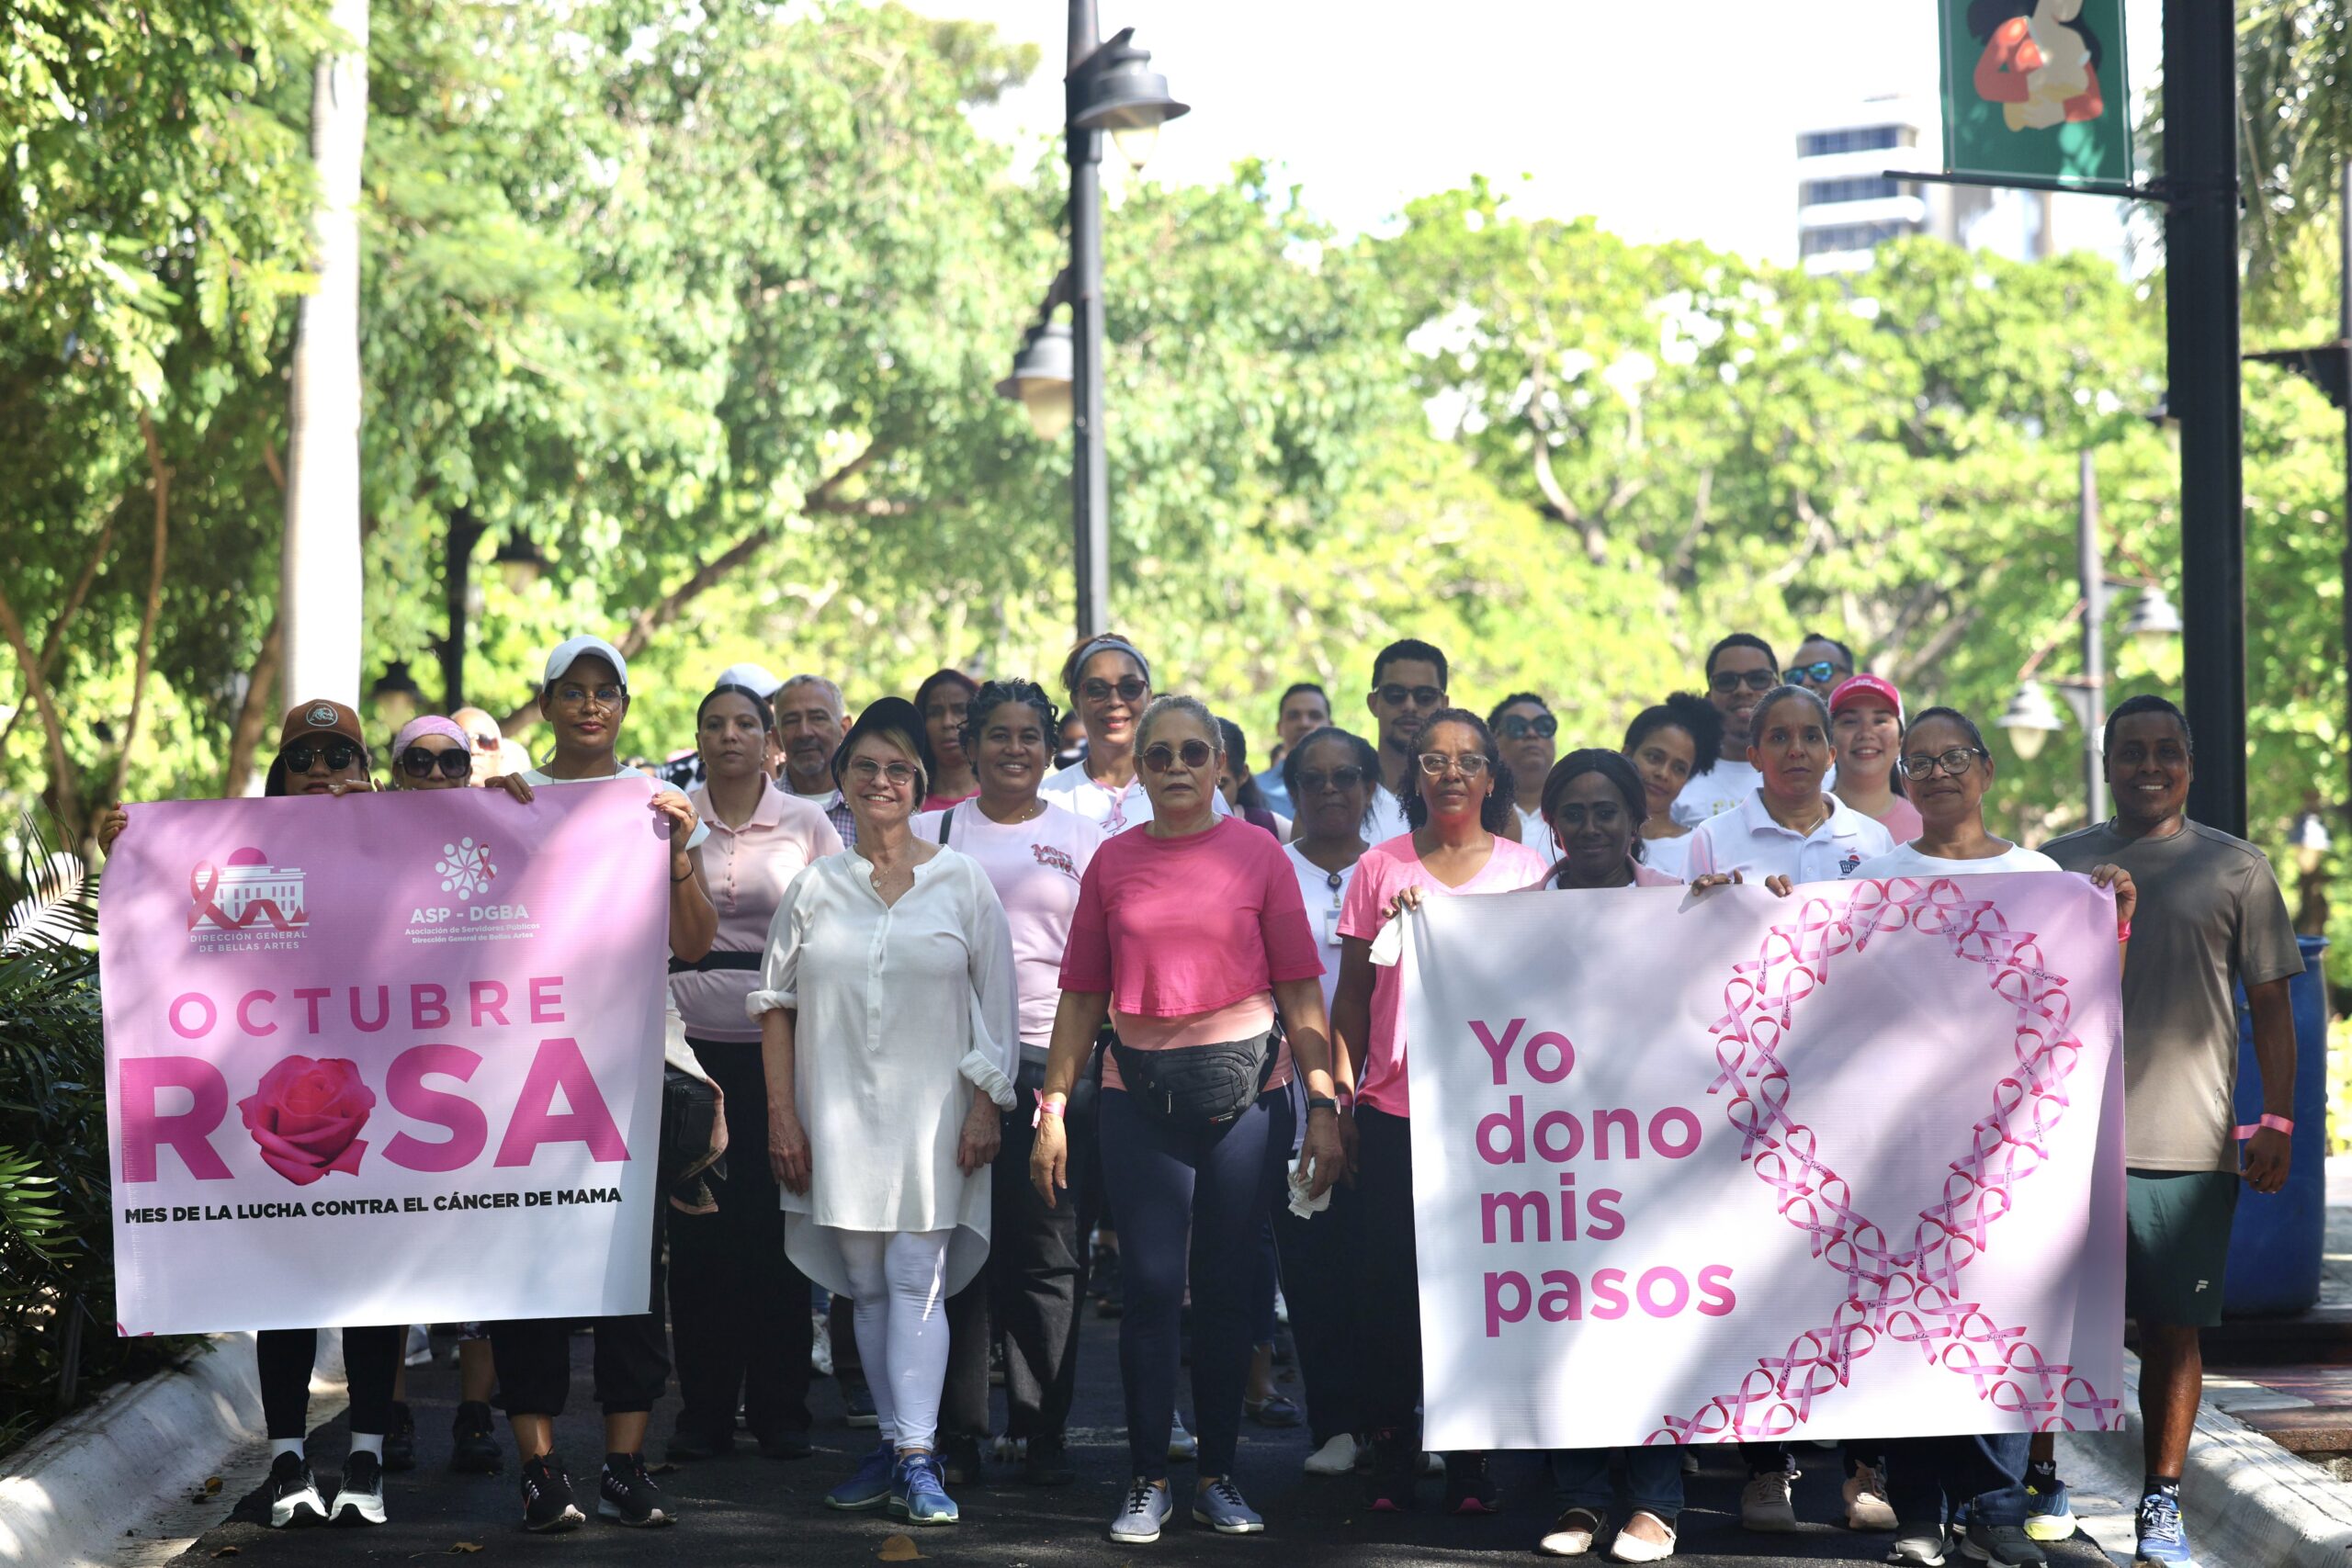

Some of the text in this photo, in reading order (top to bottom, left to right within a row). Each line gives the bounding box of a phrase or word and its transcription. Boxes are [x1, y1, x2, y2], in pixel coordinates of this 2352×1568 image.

[405, 926, 448, 936] Asociación
[449, 926, 459, 934] de
[461, 923, 505, 933] Servidores
[411, 907, 451, 924] ASP
[469, 904, 529, 921] DGBA
[190, 931, 309, 943] DIRECCIÓN GENERAL
[199, 942, 300, 953] DE BELLAS ARTES
[412, 931, 535, 944] Dirección General de Bellas Artes
[168, 976, 566, 1040] OCTUBRE
[1467, 1018, 1576, 1086] Yo
[1476, 1095, 1702, 1166] dono
[125, 1187, 623, 1224] MES DE LA LUCHA CONTRA EL CÁNCER DE MAMA
[1481, 1172, 1626, 1244] mis
[1484, 1264, 1736, 1337] pasos
